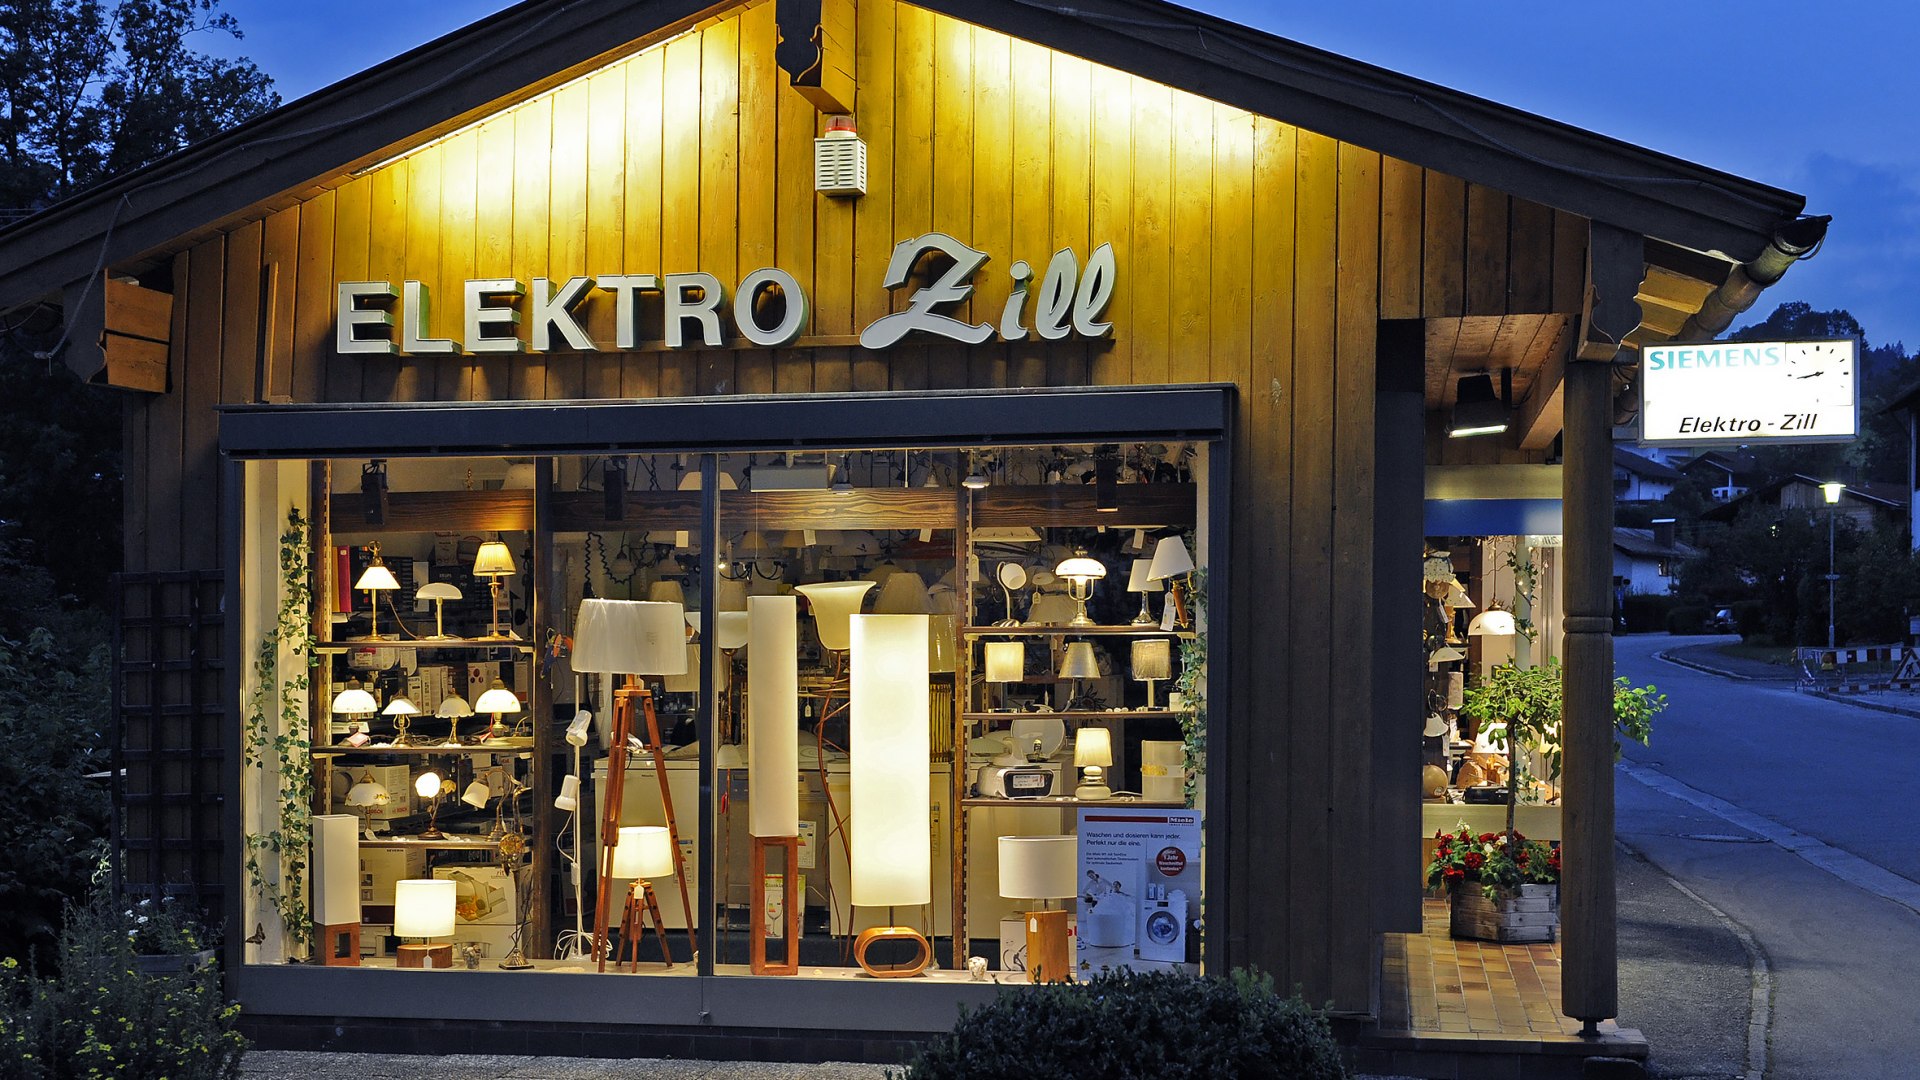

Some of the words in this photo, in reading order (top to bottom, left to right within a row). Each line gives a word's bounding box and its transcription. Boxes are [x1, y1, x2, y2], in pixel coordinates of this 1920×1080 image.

[336, 267, 808, 356] ELEKTRO
[860, 231, 1117, 349] Zill
[1650, 347, 1780, 370] SIEMENS
[1678, 416, 1761, 433] Elektro
[1780, 413, 1818, 430] Zill
